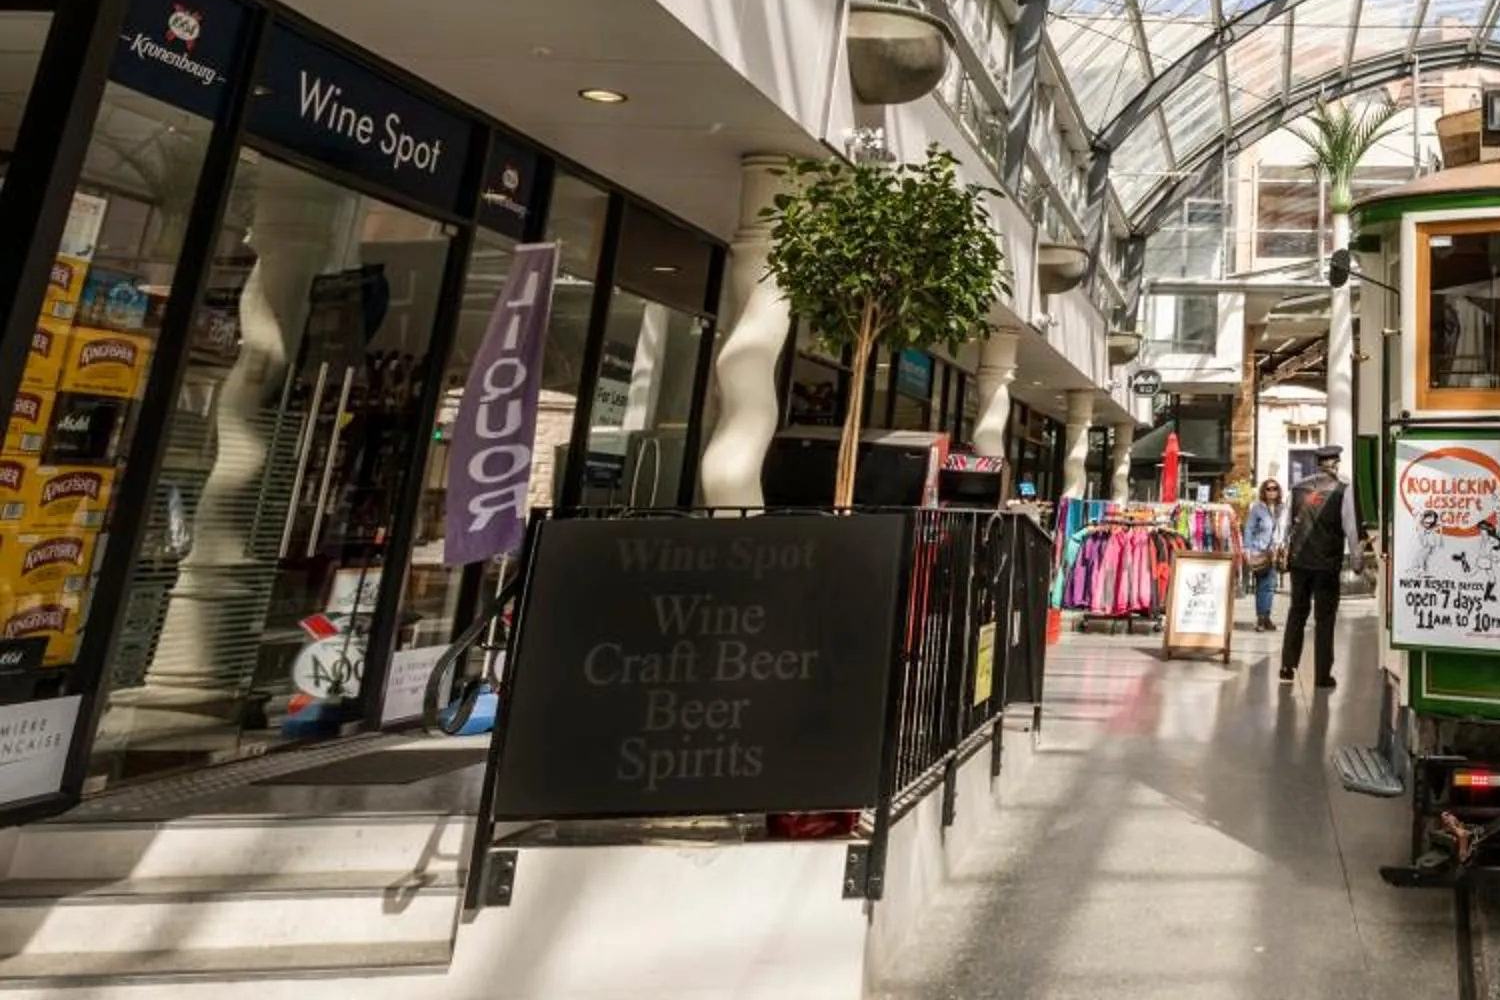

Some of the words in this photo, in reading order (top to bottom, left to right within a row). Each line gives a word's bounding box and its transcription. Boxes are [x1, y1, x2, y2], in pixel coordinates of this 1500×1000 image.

[130, 33, 217, 85] Kronenbourg
[300, 70, 374, 144] Wine
[380, 112, 440, 173] Spot
[1407, 477, 1497, 495] ROLLICKIN
[1424, 496, 1482, 511] dessert
[616, 537, 718, 573] Wine
[729, 536, 817, 580] Spot
[652, 592, 767, 636] Wine
[1406, 591, 1437, 615] open
[1441, 589, 1450, 609] 7
[1454, 591, 1483, 616] days
[1456, 613, 1469, 627] to
[583, 639, 701, 687] Craft
[712, 640, 820, 682] Beer
[641, 689, 752, 732] Beer
[616, 733, 766, 793] Spirits
